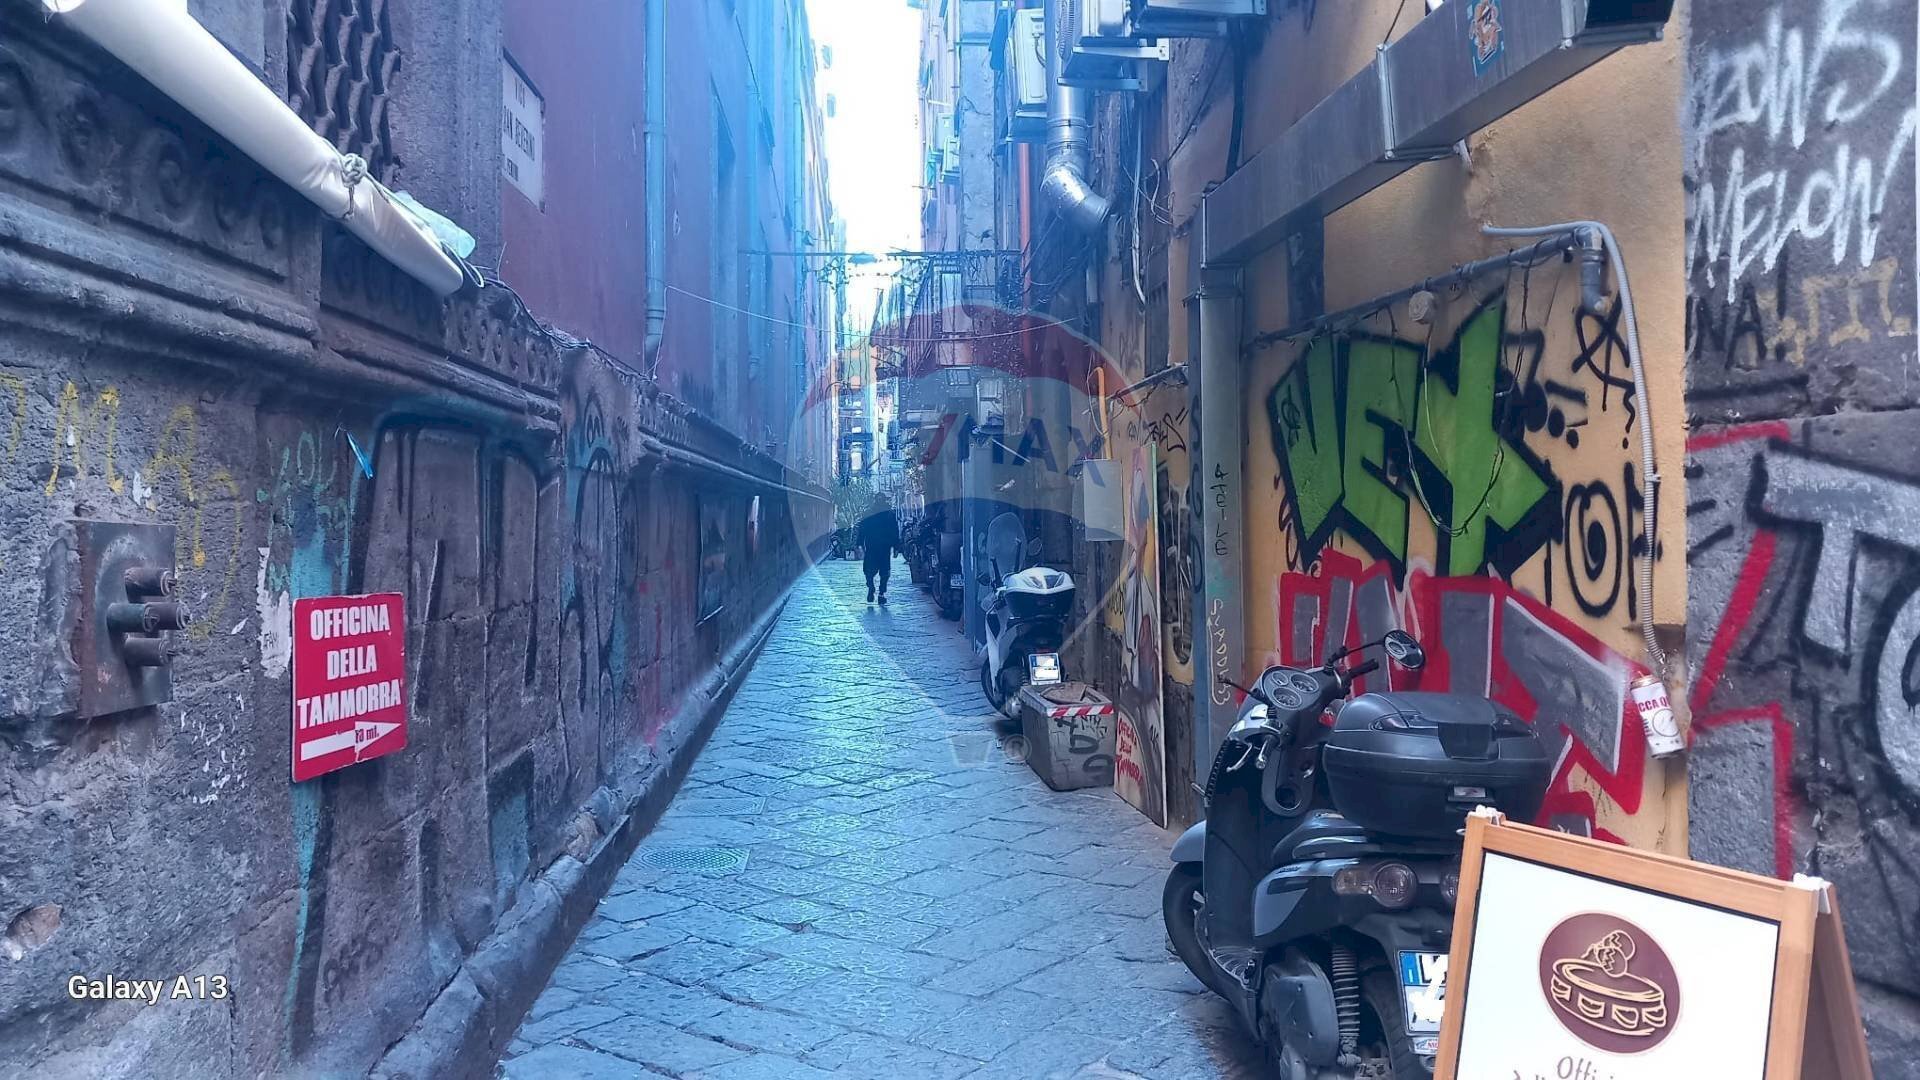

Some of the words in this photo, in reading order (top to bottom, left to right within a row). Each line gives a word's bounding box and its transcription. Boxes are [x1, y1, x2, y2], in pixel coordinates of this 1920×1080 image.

[310, 604, 390, 640] OFFICINA
[327, 645, 377, 680] DELLA
[297, 679, 401, 730] TAMMORRA
